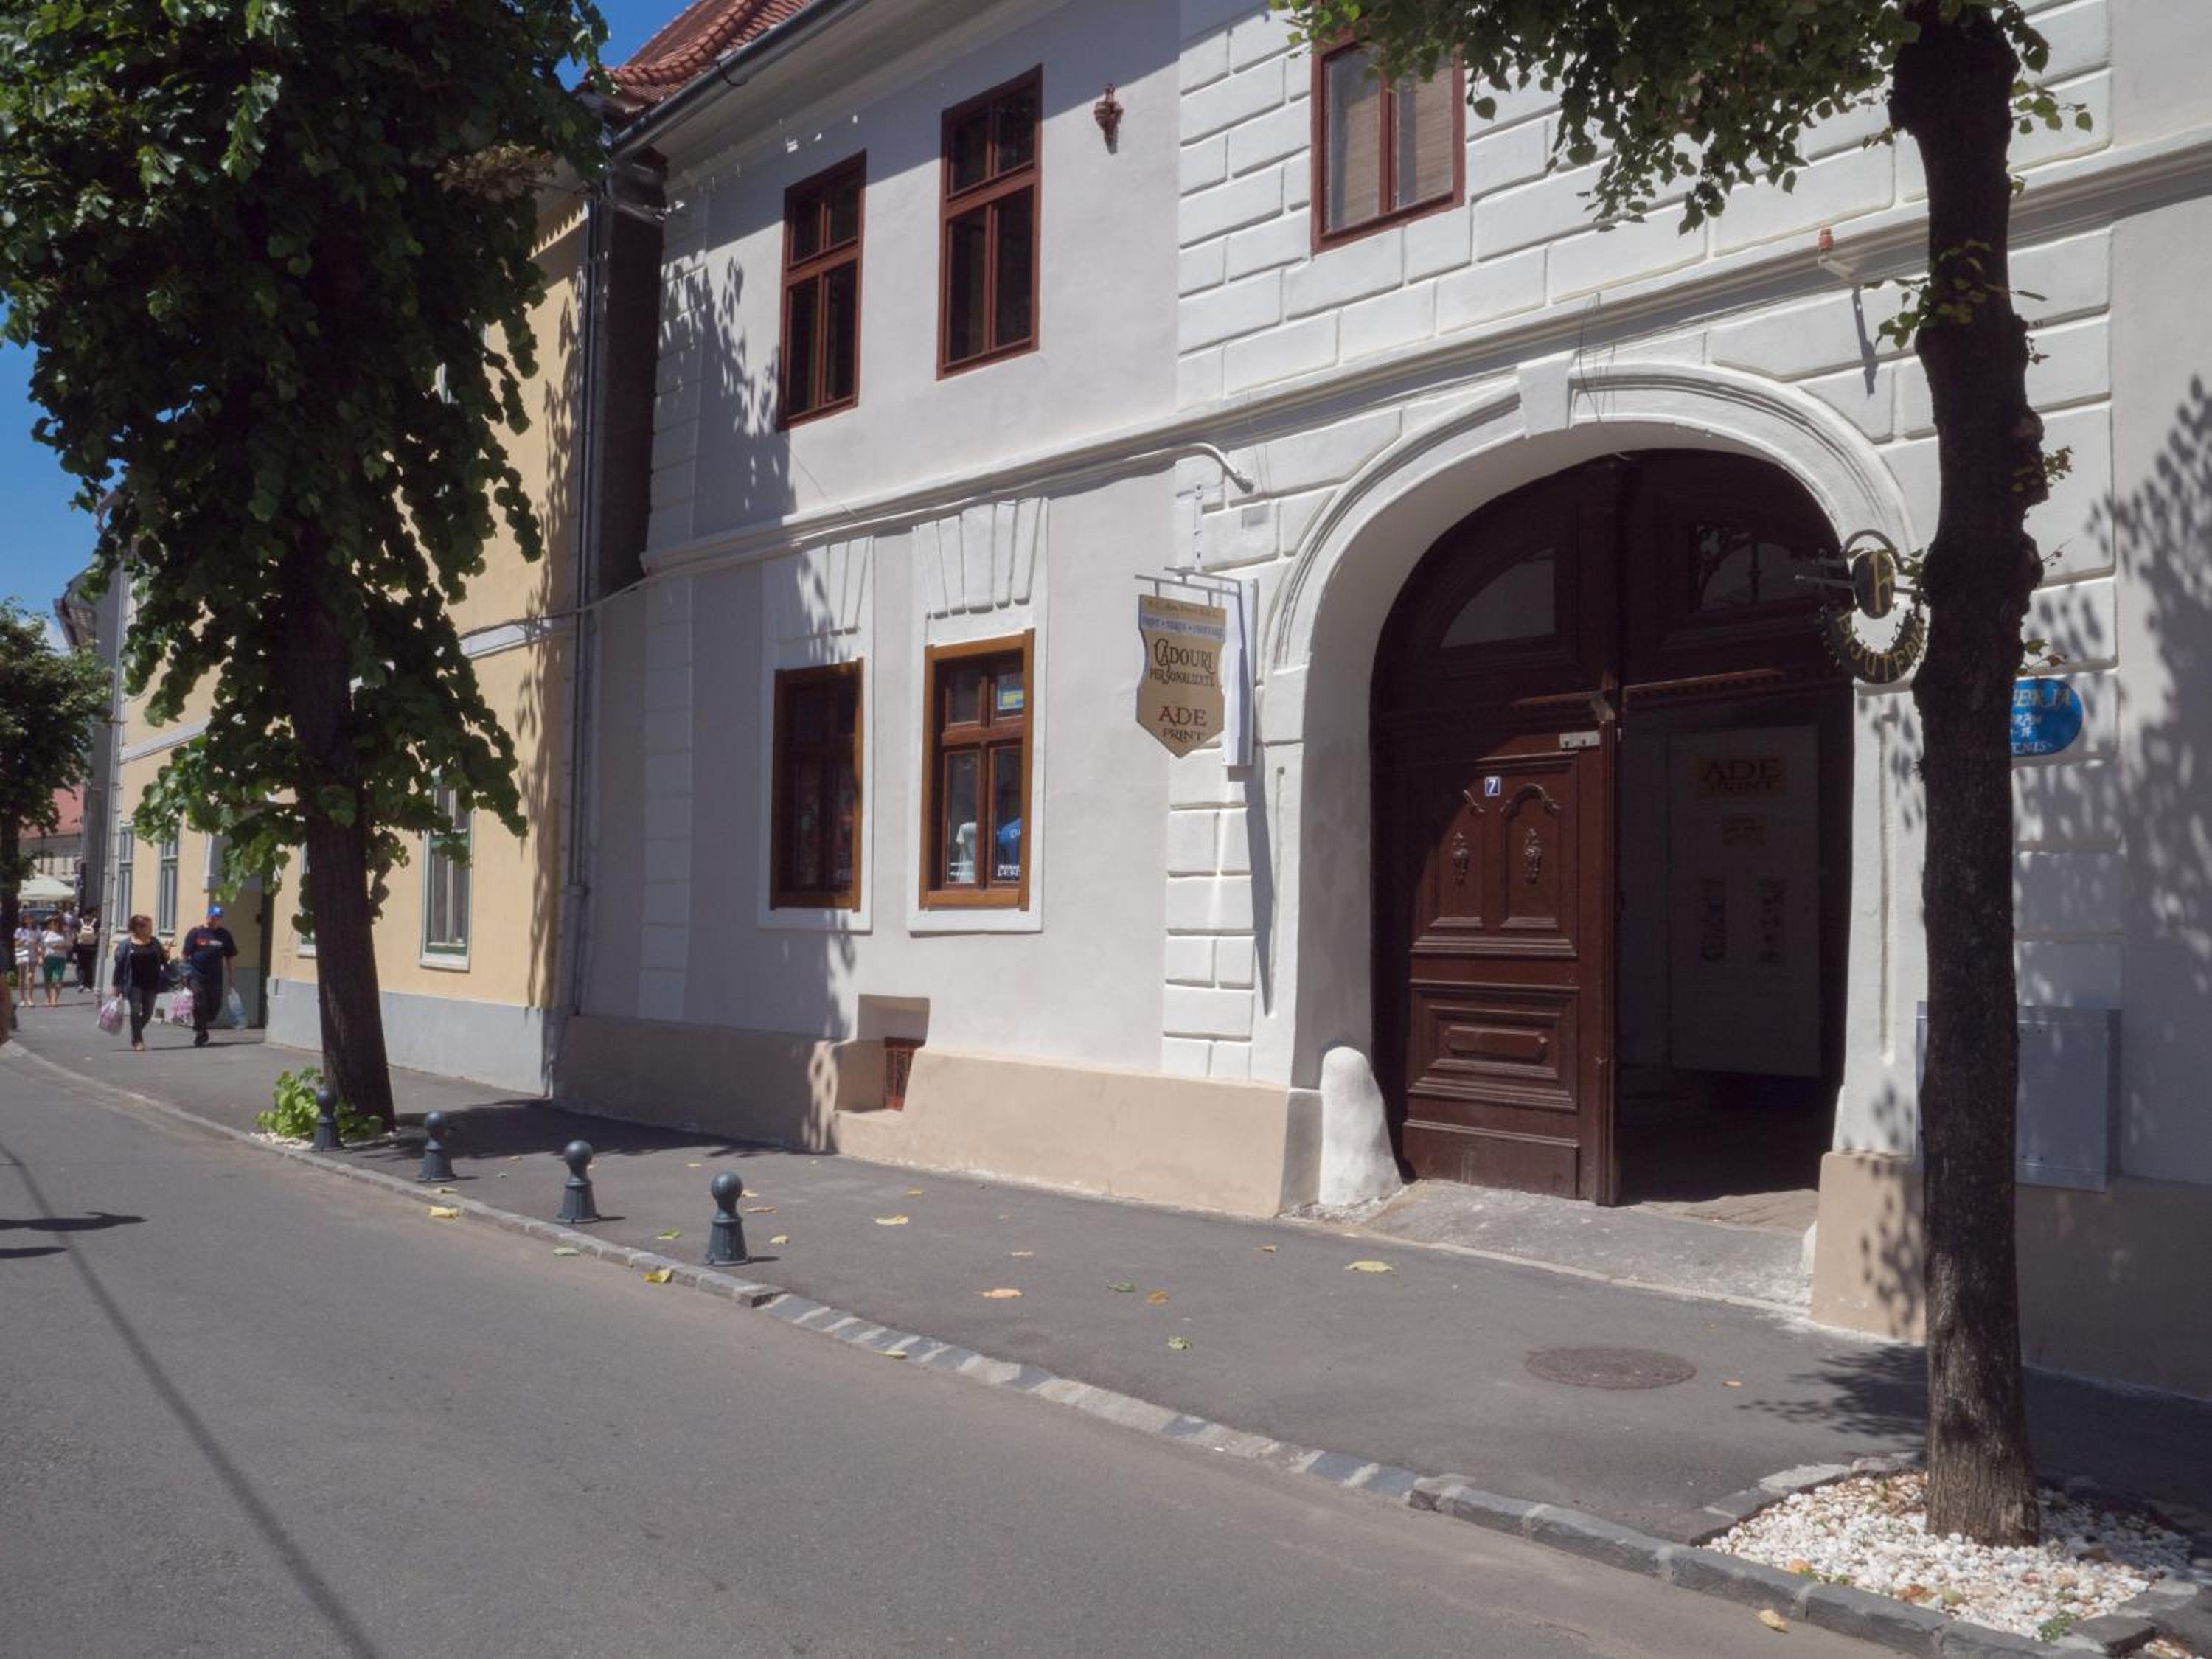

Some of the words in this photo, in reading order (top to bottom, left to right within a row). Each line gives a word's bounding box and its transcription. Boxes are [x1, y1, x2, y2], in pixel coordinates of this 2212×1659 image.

[1154, 638, 1215, 674] CADOURI
[1158, 706, 1207, 727] ADE
[1162, 728, 1205, 742] PRINT
[1700, 758, 1781, 780] ADE
[1489, 779, 1498, 794] 7
